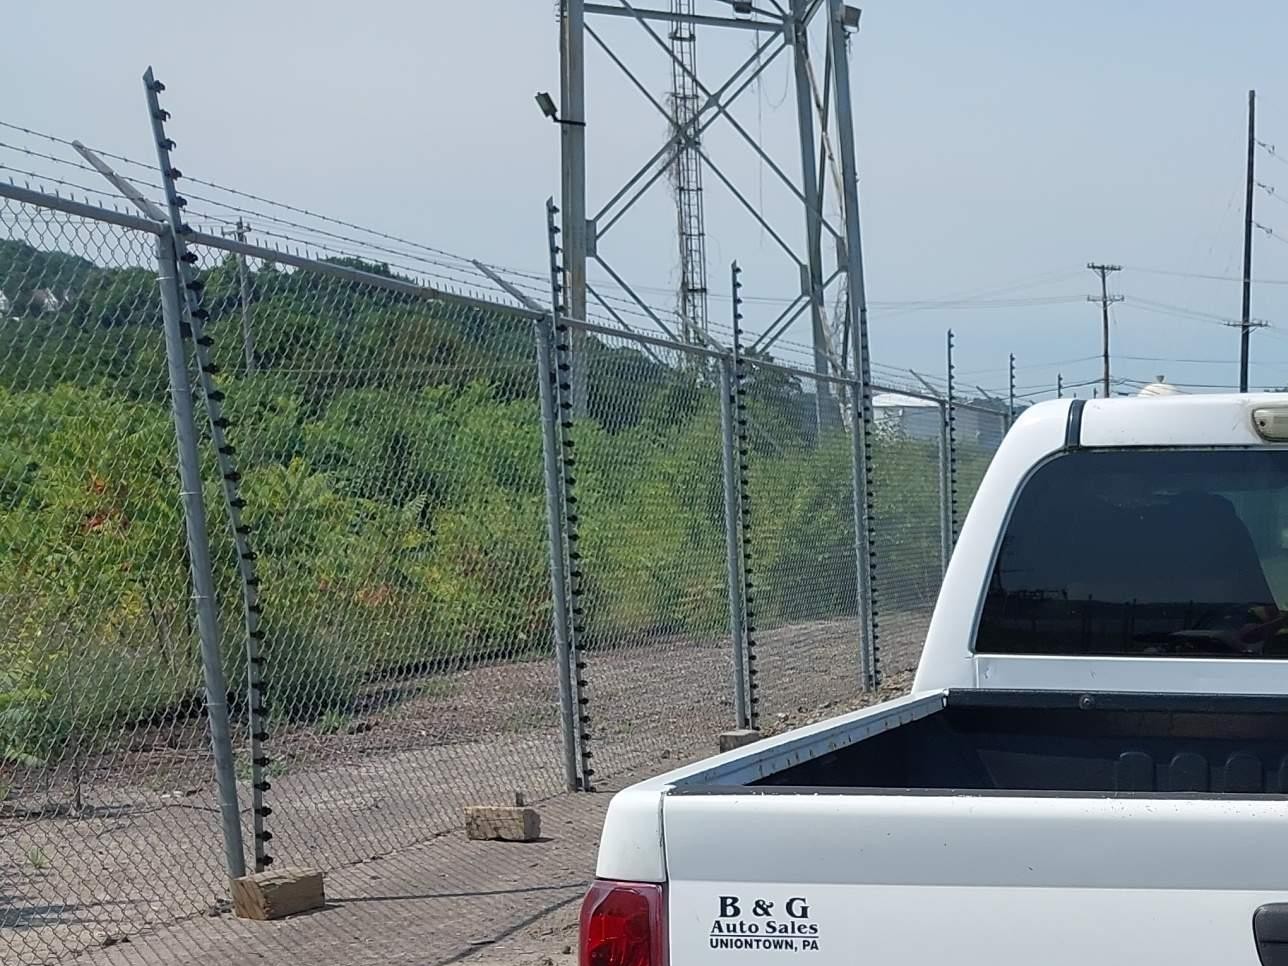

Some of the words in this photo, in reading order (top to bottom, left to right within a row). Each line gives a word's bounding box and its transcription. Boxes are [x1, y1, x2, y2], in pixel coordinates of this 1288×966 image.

[718, 896, 741, 917] B
[752, 899, 774, 917] &
[785, 897, 810, 918] G
[711, 920, 759, 933] Auto
[765, 920, 818, 934] Sales
[710, 938, 798, 952] UNIONTOWN,
[802, 939, 819, 950] PA
